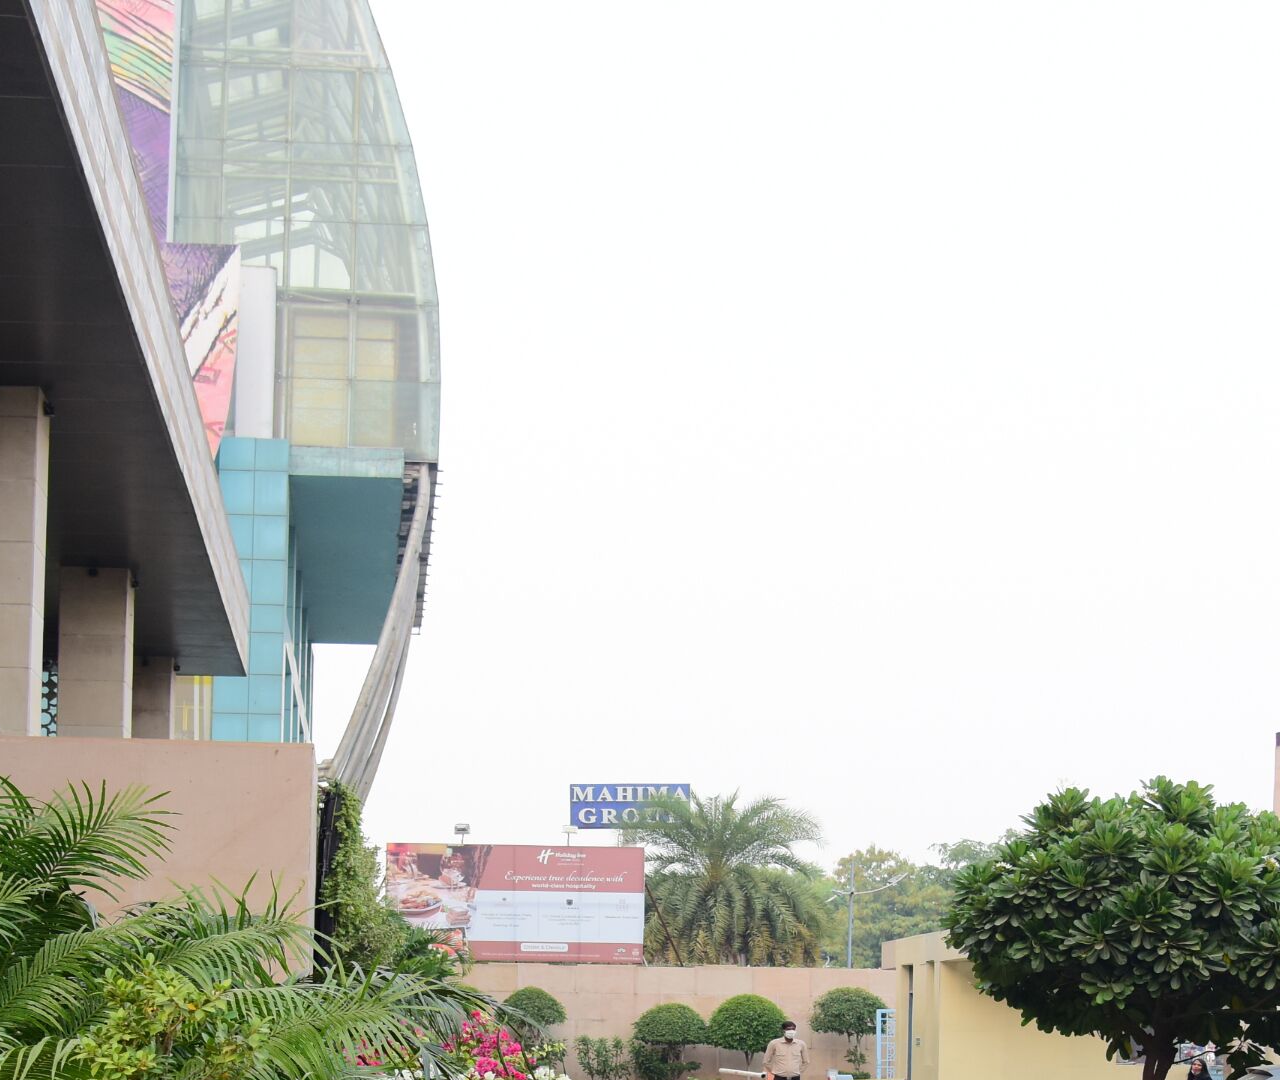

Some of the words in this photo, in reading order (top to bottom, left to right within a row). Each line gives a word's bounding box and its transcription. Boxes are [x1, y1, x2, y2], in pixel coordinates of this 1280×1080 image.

[571, 786, 689, 802] MAHIMA
[505, 871, 548, 883] Experience
[549, 874, 565, 882] true
[566, 871, 605, 882] decadence
[606, 872, 627, 883] with
